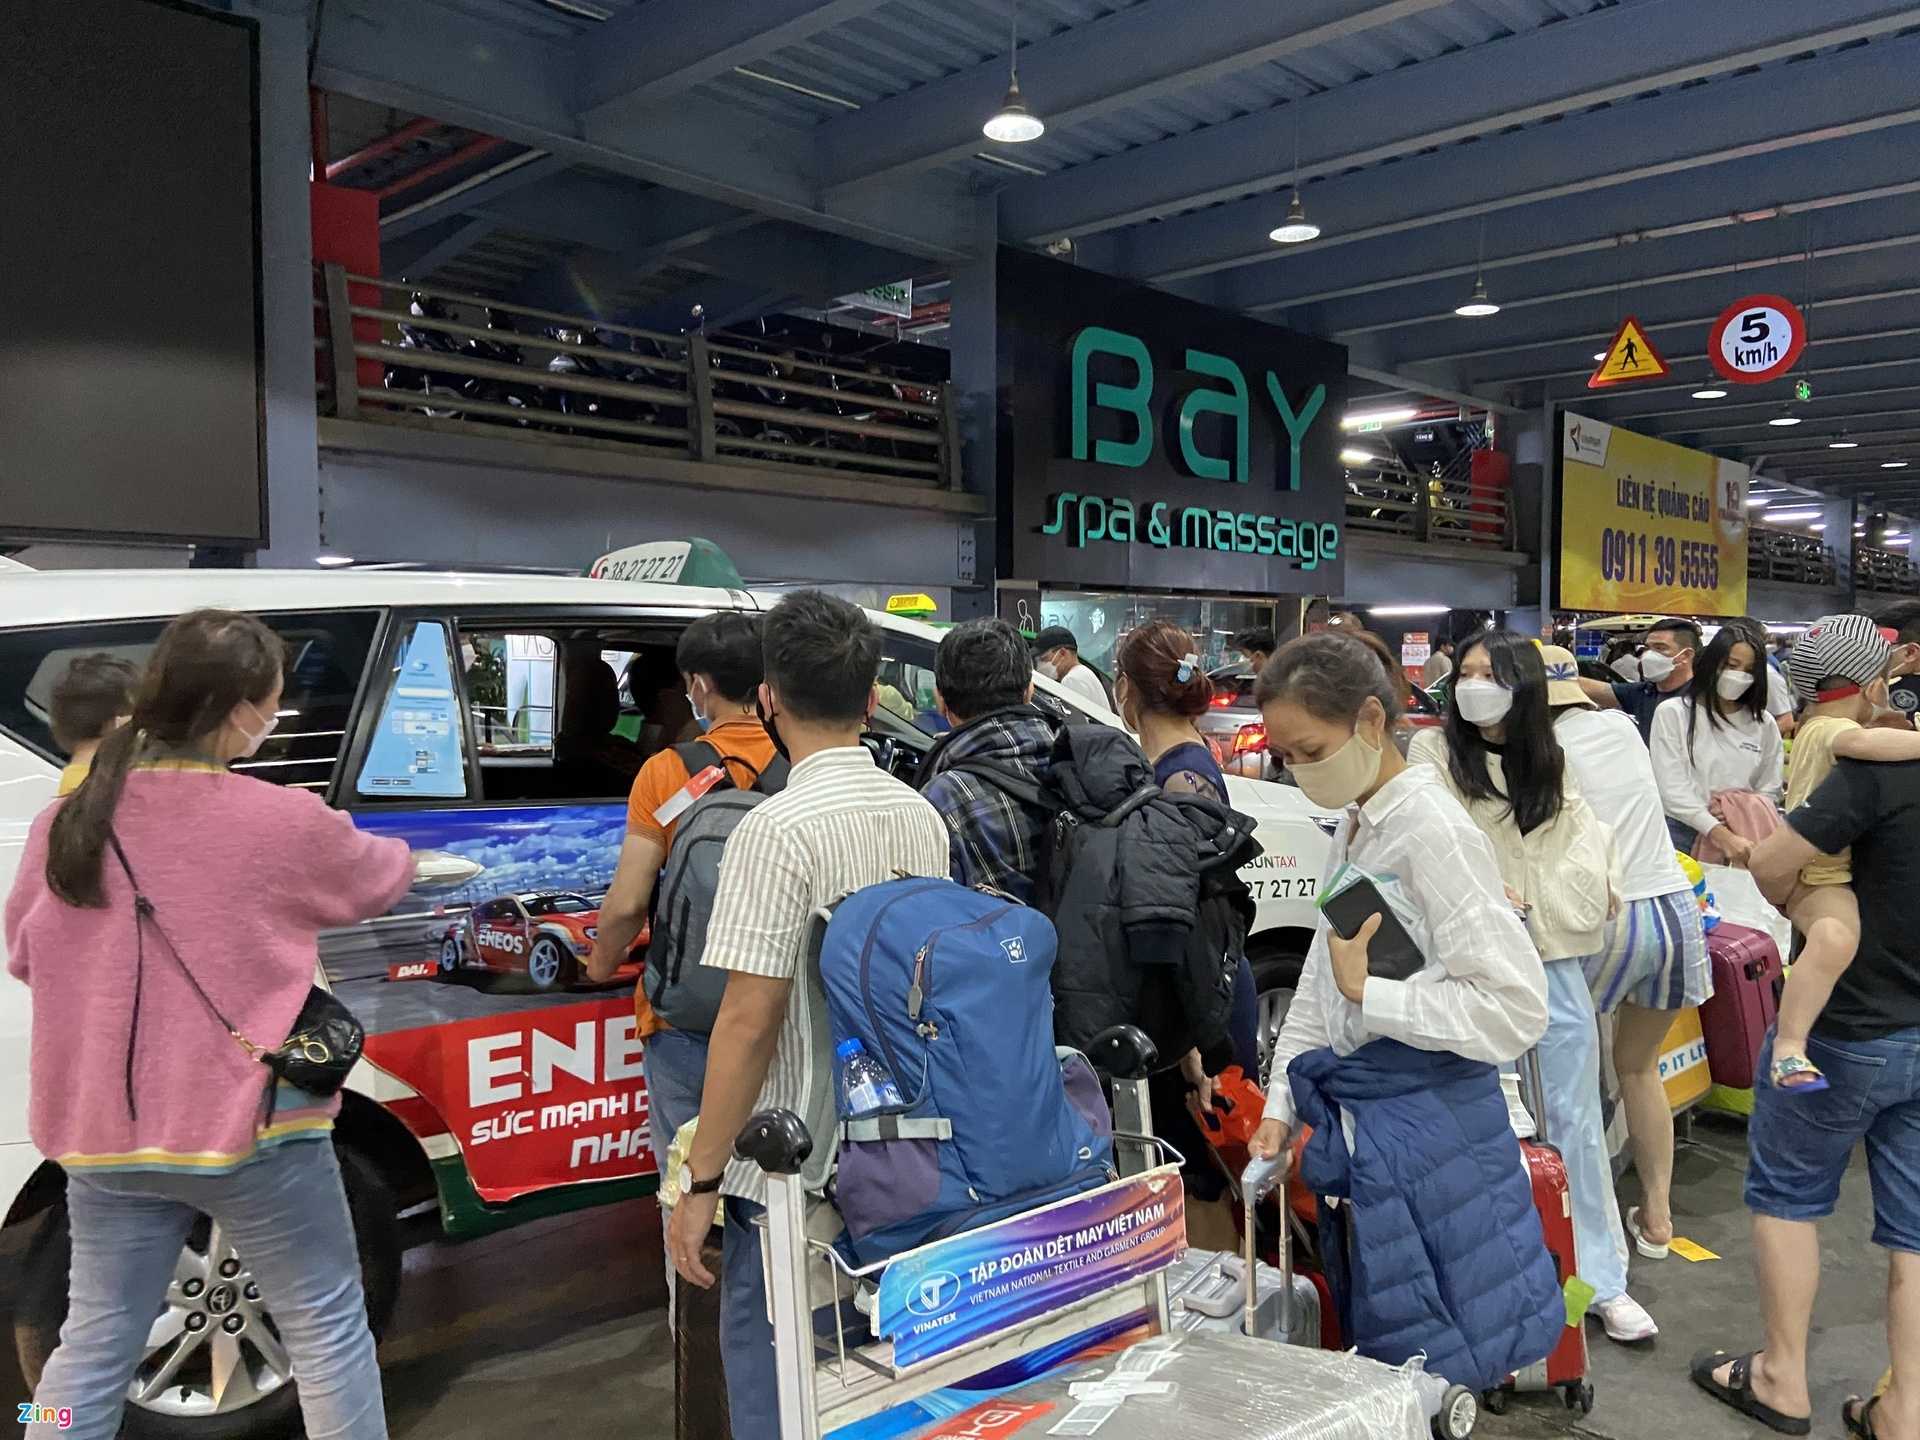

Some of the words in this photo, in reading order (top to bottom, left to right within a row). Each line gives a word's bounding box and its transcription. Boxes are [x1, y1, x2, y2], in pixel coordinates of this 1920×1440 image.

[1740, 311, 1770, 343] 5
[1734, 342, 1778, 366] km/h
[1616, 475, 1640, 510] LIÊN
[1643, 480, 1656, 519] HỆ
[1658, 482, 1690, 520] QUẢNG
[1692, 491, 1710, 523] CÁO
[1043, 493, 1135, 548] spa
[1148, 502, 1170, 548] &
[1182, 507, 1338, 570] massage
[640, 556, 667, 580] 27
[660, 554, 685, 579] 27
[1602, 527, 1647, 583] 0911
[1654, 536, 1676, 586] 39
[1680, 540, 1719, 590] 5555
[1271, 879, 1292, 898] 27
[1297, 878, 1316, 897] 27
[477, 928, 523, 955] ENEOS
[1672, 1053, 1685, 1070] IT
[470, 1110, 535, 1146] SỨC
[968, 1261, 998, 1286] TẬP
[1000, 1245, 1045, 1275] ĐOÀN
[1047, 1235, 1074, 1260] DỆT
[1075, 1223, 1106, 1250] MAY
[1105, 1212, 1134, 1237] VIỆT
[1134, 1202, 1166, 1228] NAM
[969, 1284, 1010, 1306] VIETNAM
[1011, 1267, 1052, 1292] NATIONAL
[1053, 1257, 1085, 1276] TEXTILE
[1085, 1252, 1104, 1266] AND
[1104, 1238, 1141, 1257] GARMENT
[1140, 1225, 1166, 1243] GROUP
[912, 1311, 957, 1335] VINATEX
